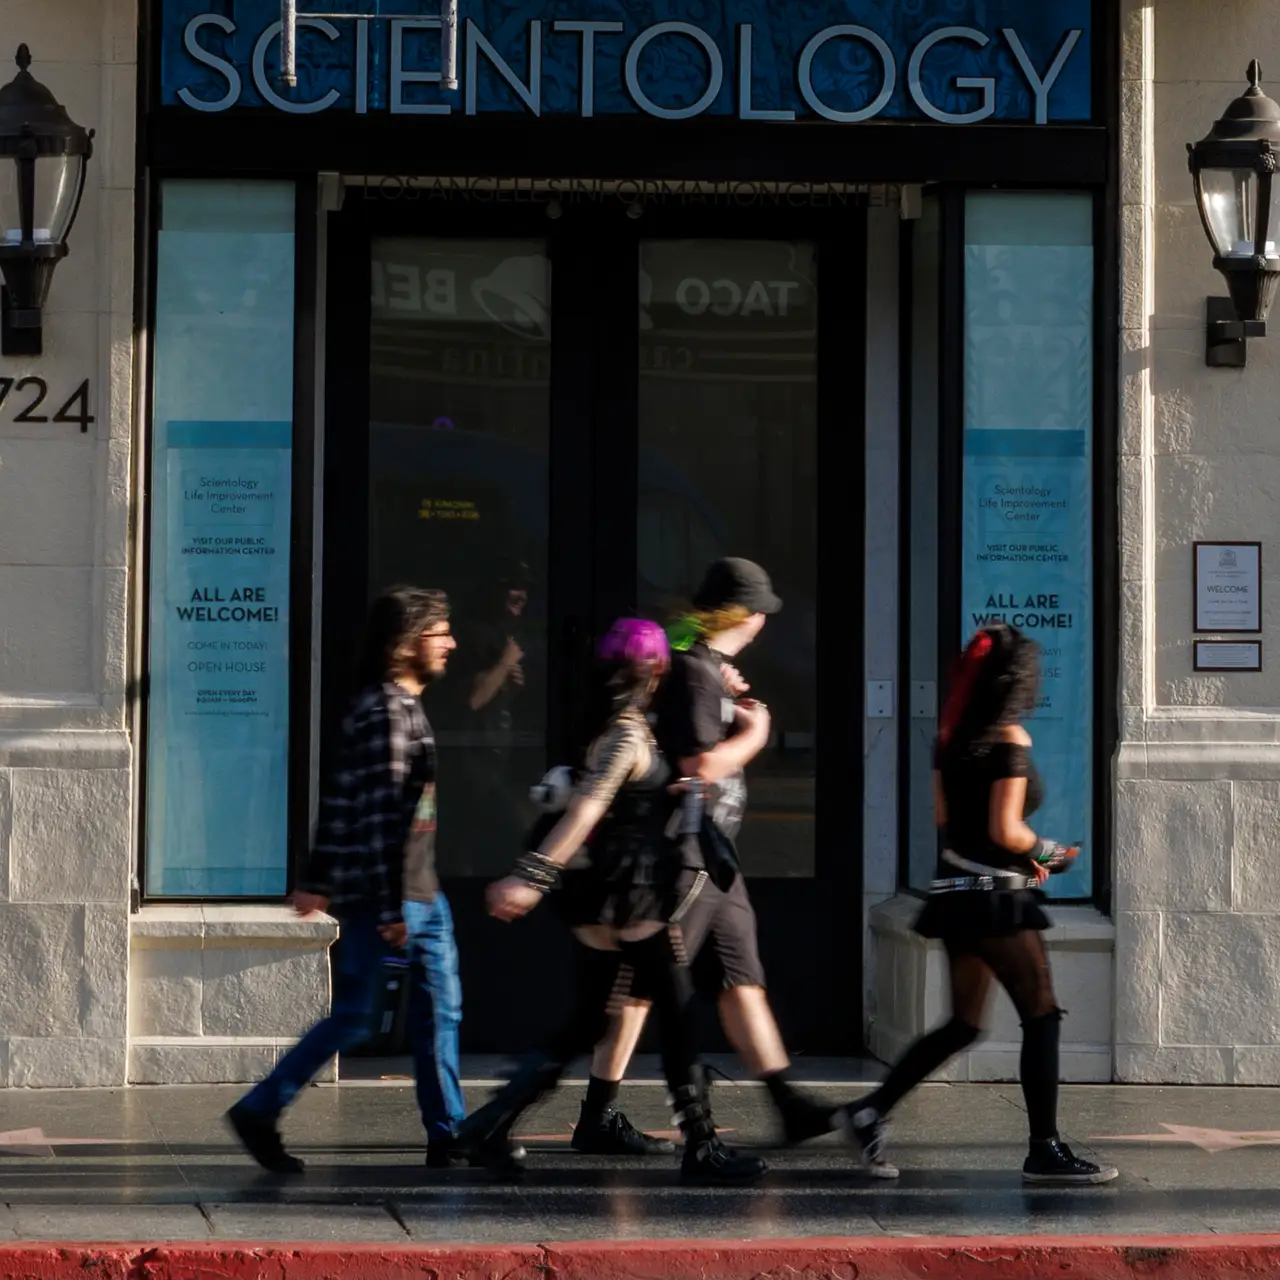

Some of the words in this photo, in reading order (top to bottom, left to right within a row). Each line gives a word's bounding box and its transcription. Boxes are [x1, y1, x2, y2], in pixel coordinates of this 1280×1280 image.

[175, 13, 1083, 125] SCIENTOLOGY
[362, 174, 421, 201] LOS
[427, 176, 563, 203] ANGELES
[568, 178, 780, 208] INFORMATION
[785, 179, 901, 209] CENTER
[199, 476, 260, 489] Scientology
[184, 490, 204, 500] Life
[206, 490, 274, 502] Improvement
[993, 484, 1052, 497] Scientology
[210, 503, 246, 514] Center
[978, 498, 998, 508] Life
[1000, 498, 1067, 510] Improvement
[1005, 510, 1040, 521] Center
[192, 537, 213, 546] VISIT
[214, 537, 234, 546] OUR
[234, 537, 266, 546] PUBLIC
[181, 547, 241, 555] INFORMATION
[242, 547, 276, 555] CENTER
[986, 544, 1007, 552] VISIT
[1008, 544, 1027, 552] OUR
[1028, 544, 1059, 552] PUBLIC
[976, 554, 1035, 562] INFORMATION
[1036, 554, 1069, 562] CENTER
[190, 587, 225, 602] ALL
[229, 587, 266, 602] ARE
[1206, 585, 1249, 594] WELCOME
[985, 594, 1019, 609] ALL
[1024, 594, 1060, 609] ARE
[176, 606, 279, 622] WELCOME!
[187, 641, 217, 651] COME
[220, 641, 231, 650] IN
[187, 661, 222, 672] OPEN
[225, 661, 268, 673] HOUSE
